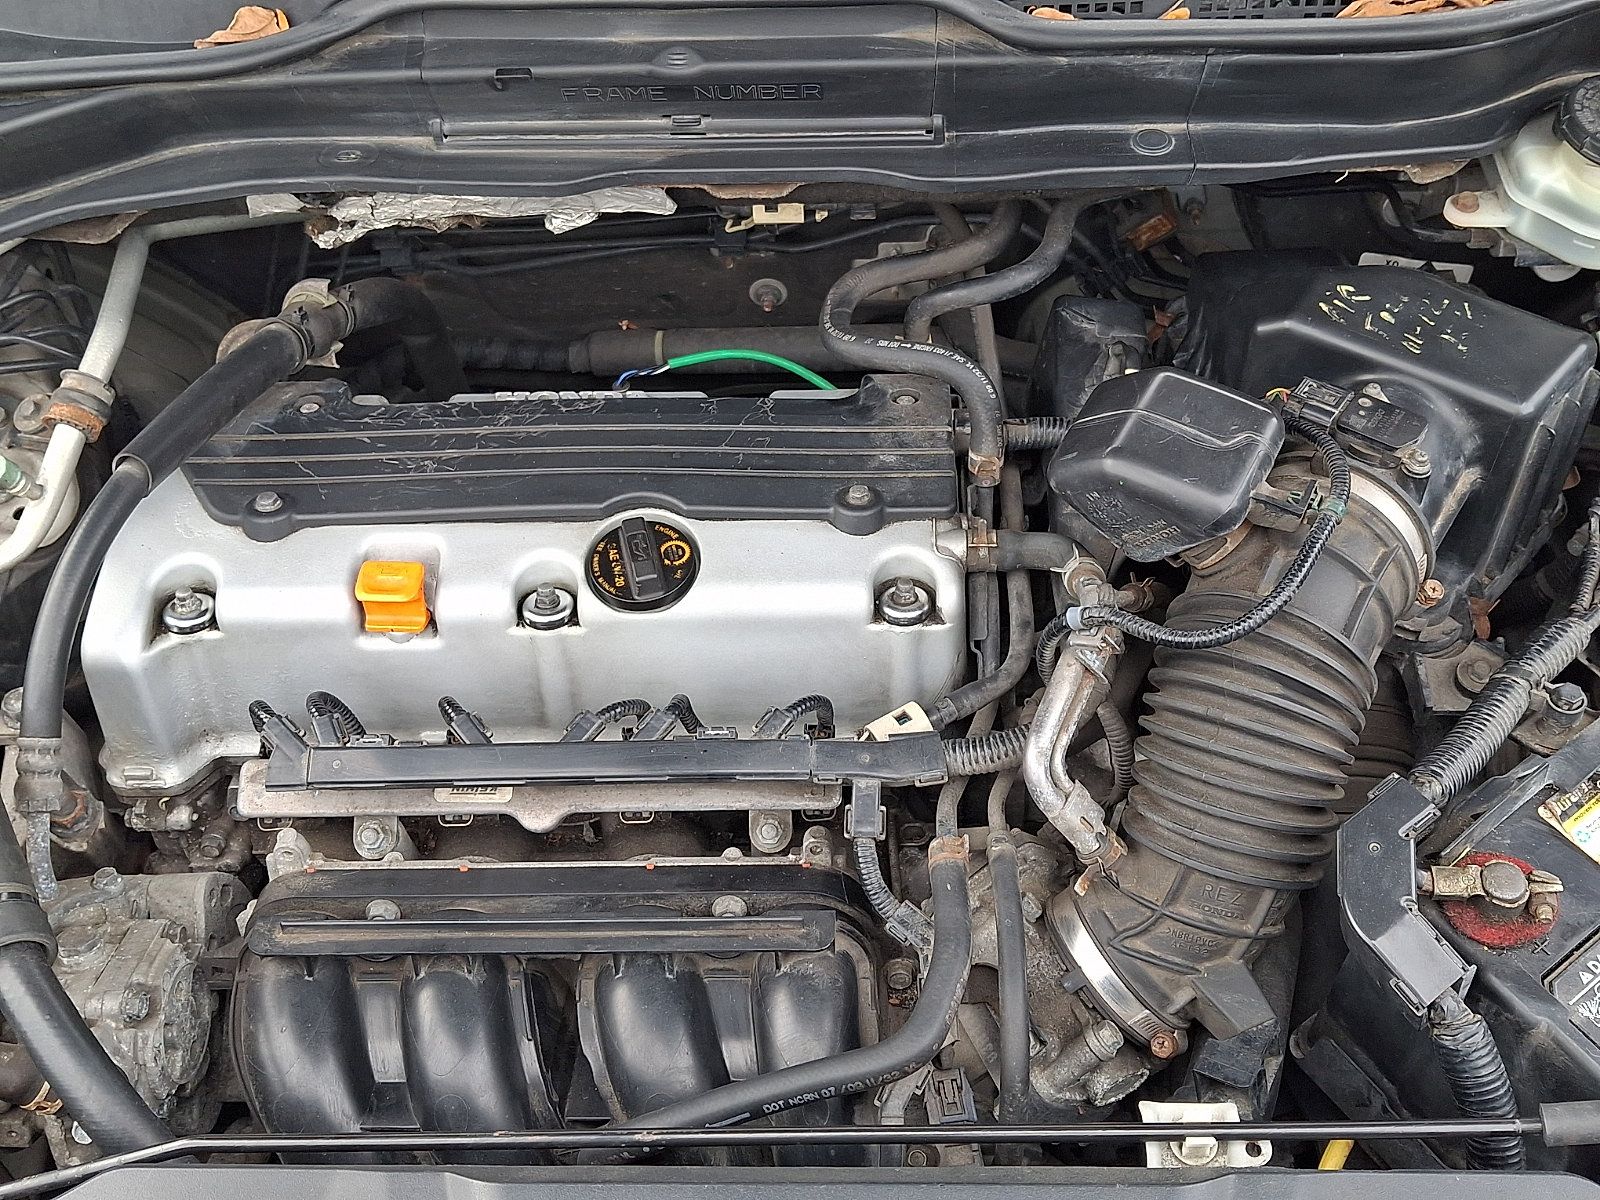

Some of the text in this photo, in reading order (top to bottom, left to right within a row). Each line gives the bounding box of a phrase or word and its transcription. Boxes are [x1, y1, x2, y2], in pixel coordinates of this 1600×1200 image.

[560, 83, 823, 102] FRAME NUMBER
[654, 523, 680, 540] ENGINE
[1201, 883, 1243, 907] REZ
[1189, 900, 1246, 921] HONDA
[762, 1101, 786, 1115] DOT
[788, 1091, 820, 1107] NCRN
